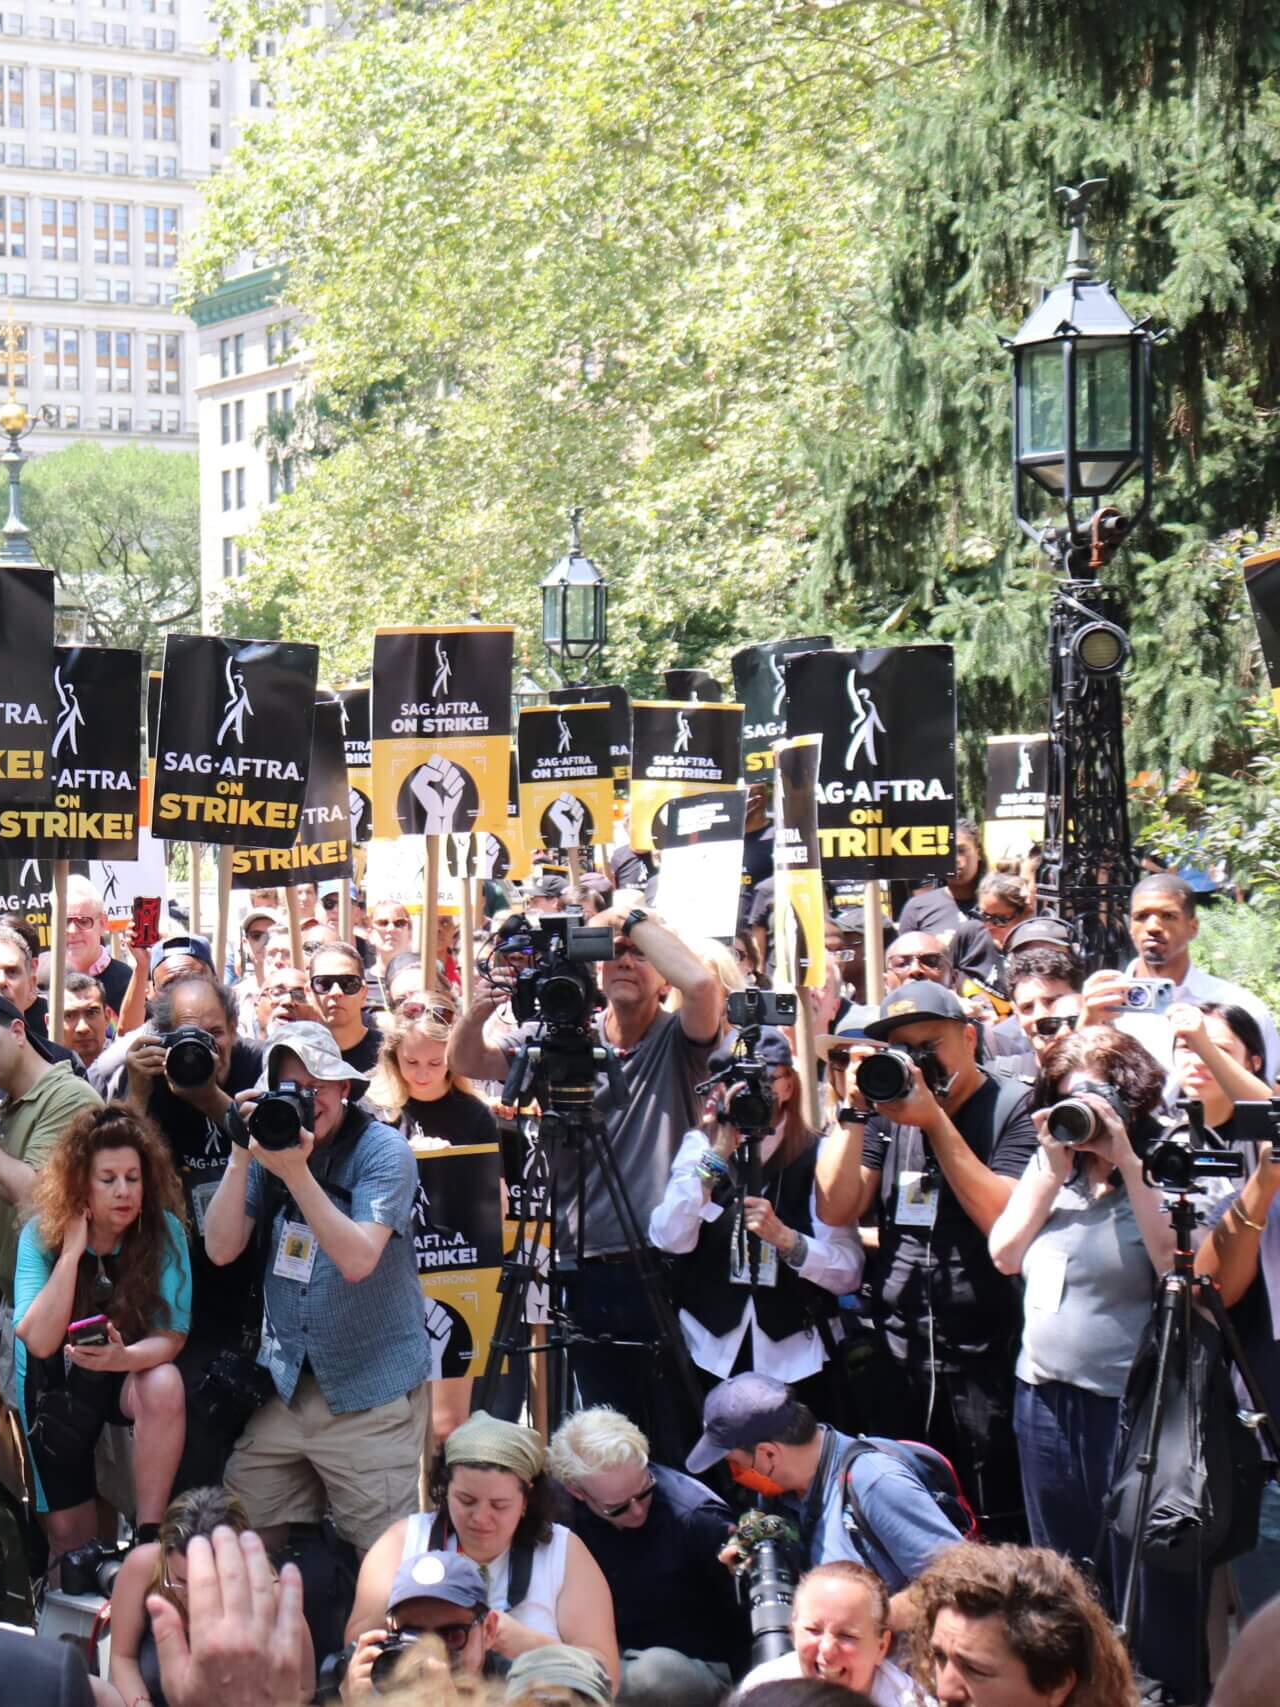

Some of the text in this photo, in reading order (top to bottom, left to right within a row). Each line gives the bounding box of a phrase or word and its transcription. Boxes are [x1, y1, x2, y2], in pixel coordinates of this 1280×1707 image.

[391, 716, 489, 733] ON STRIKE!
[531, 765, 598, 779] ON STRIKE!
[668, 767, 722, 779] STRIKE!
[216, 781, 243, 796] ON
[55, 794, 80, 810] ON
[158, 792, 299, 829] STRIKE!
[849, 809, 883, 824] ON
[0, 810, 134, 840] STRIKE!
[233, 840, 347, 875] STRIKE!
[25, 913, 48, 925] ON
